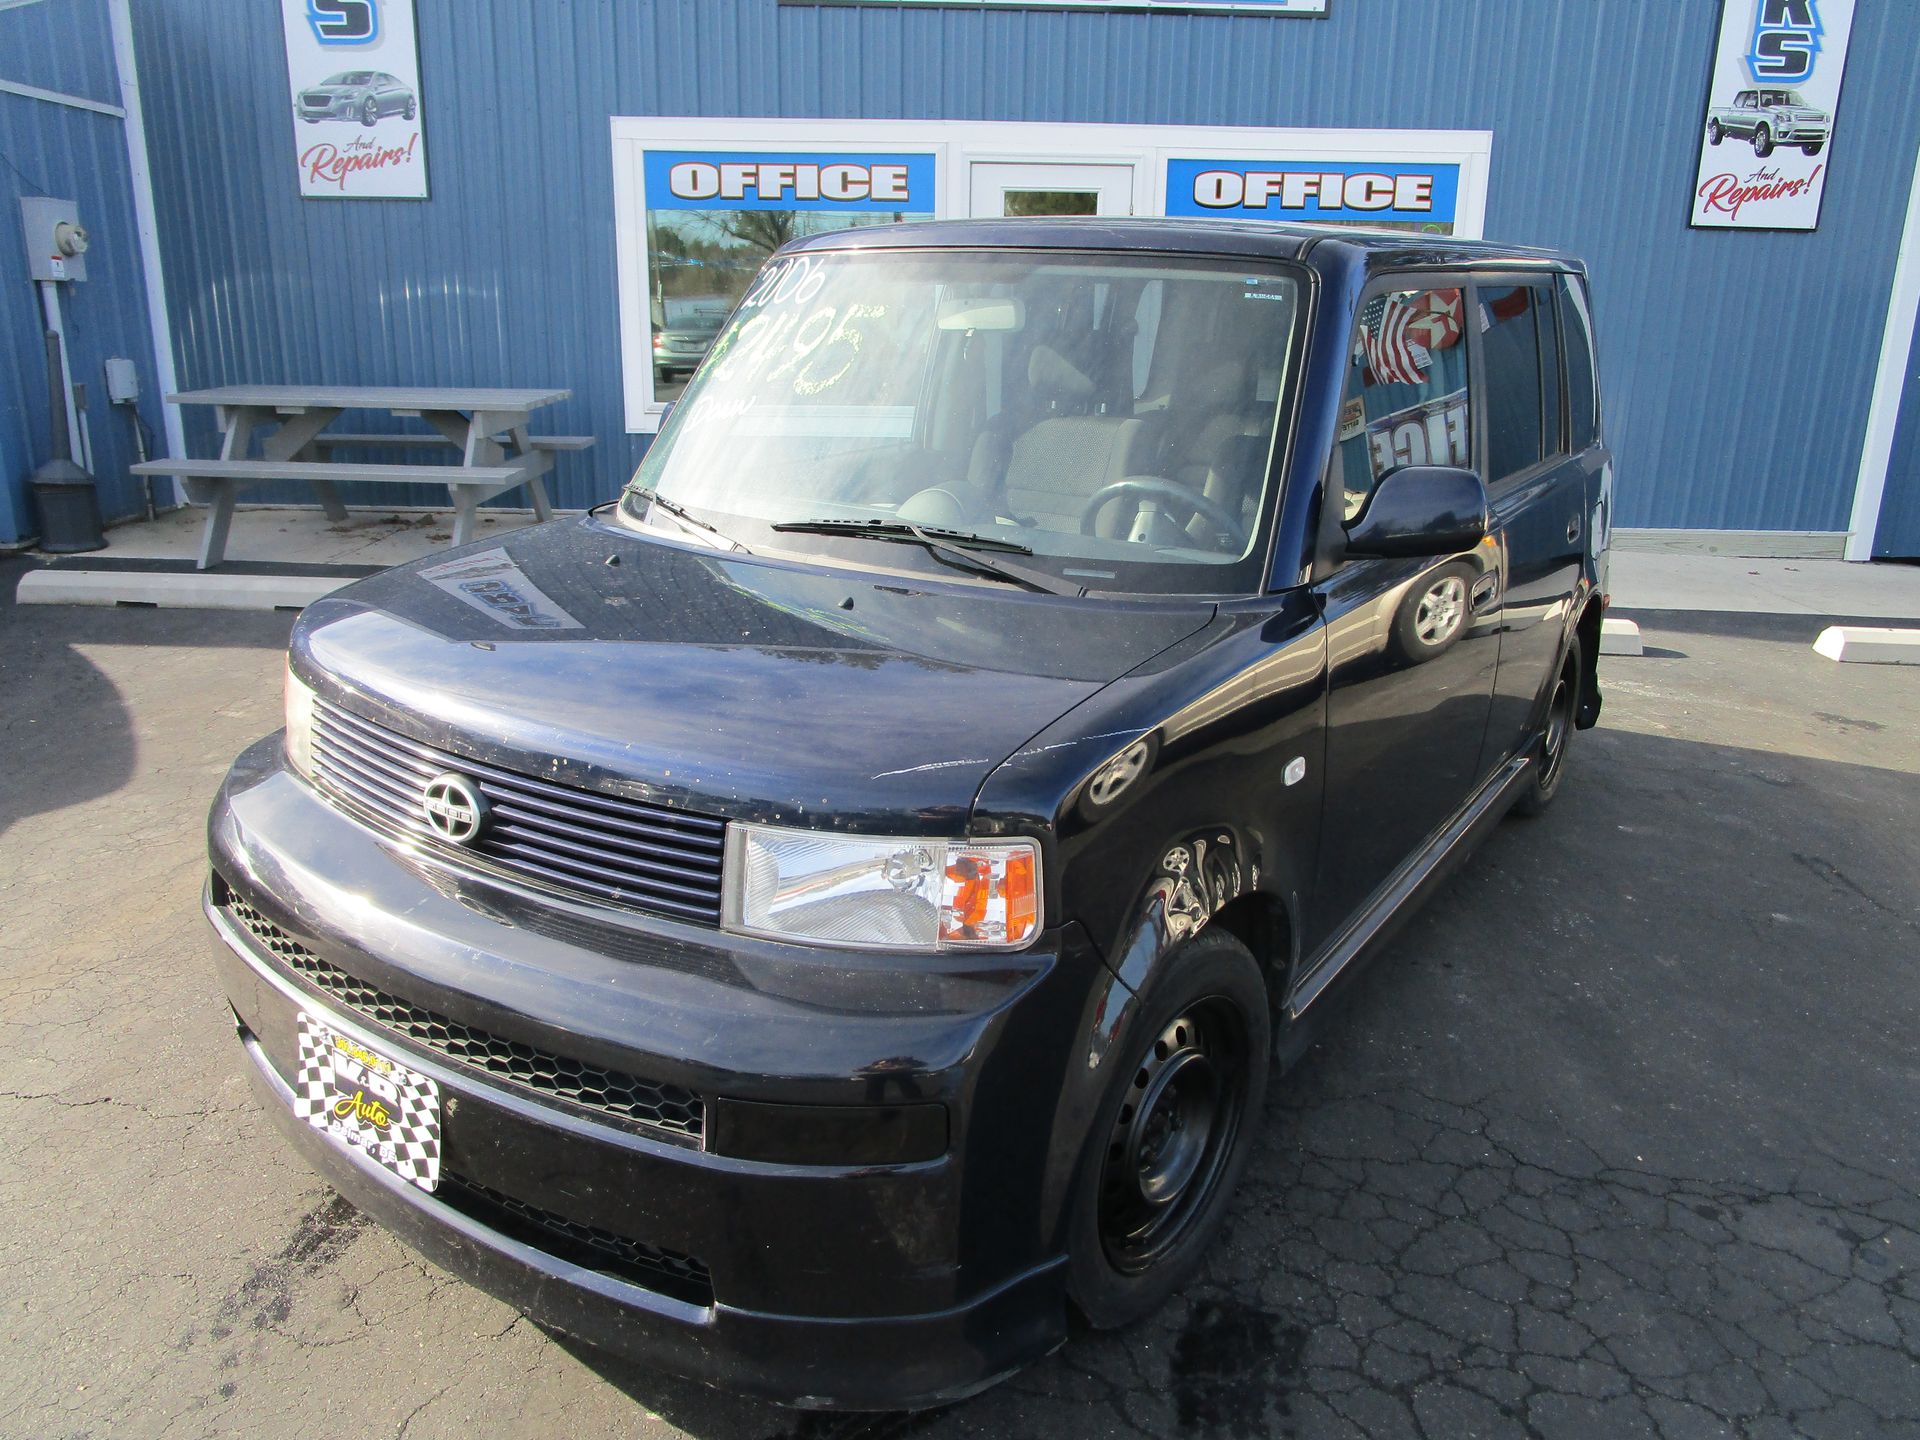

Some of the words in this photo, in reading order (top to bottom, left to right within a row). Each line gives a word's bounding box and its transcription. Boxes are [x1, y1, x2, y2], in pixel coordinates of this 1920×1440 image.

[300, 132, 419, 191] Repairs!
[343, 134, 376, 153] And
[670, 161, 910, 202] OFFICE
[1193, 170, 1434, 212] OFFICE
[1698, 164, 1823, 222] Repairs!
[1743, 166, 1780, 184] And
[741, 256, 826, 310] 2006
[334, 1090, 391, 1128] Auto
